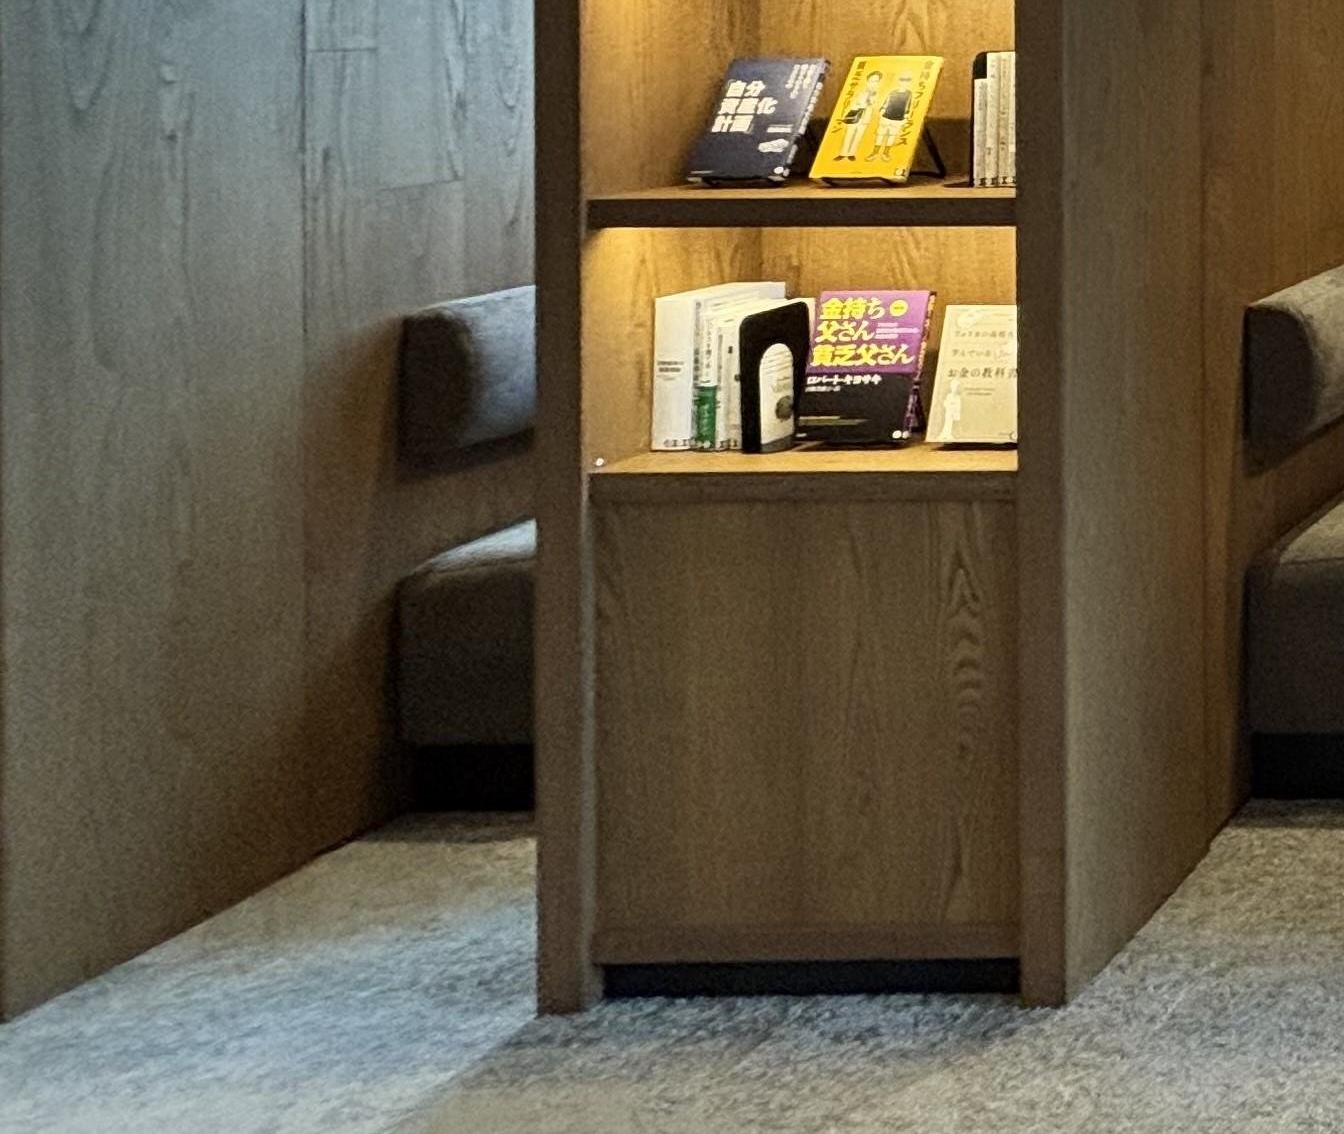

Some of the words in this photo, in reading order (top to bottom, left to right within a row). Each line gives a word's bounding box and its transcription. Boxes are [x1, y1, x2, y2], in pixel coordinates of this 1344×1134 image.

[819, 297, 886, 319] 金持ち
[815, 320, 876, 343] 父さん
[810, 344, 915, 367] 貧乏父さん
